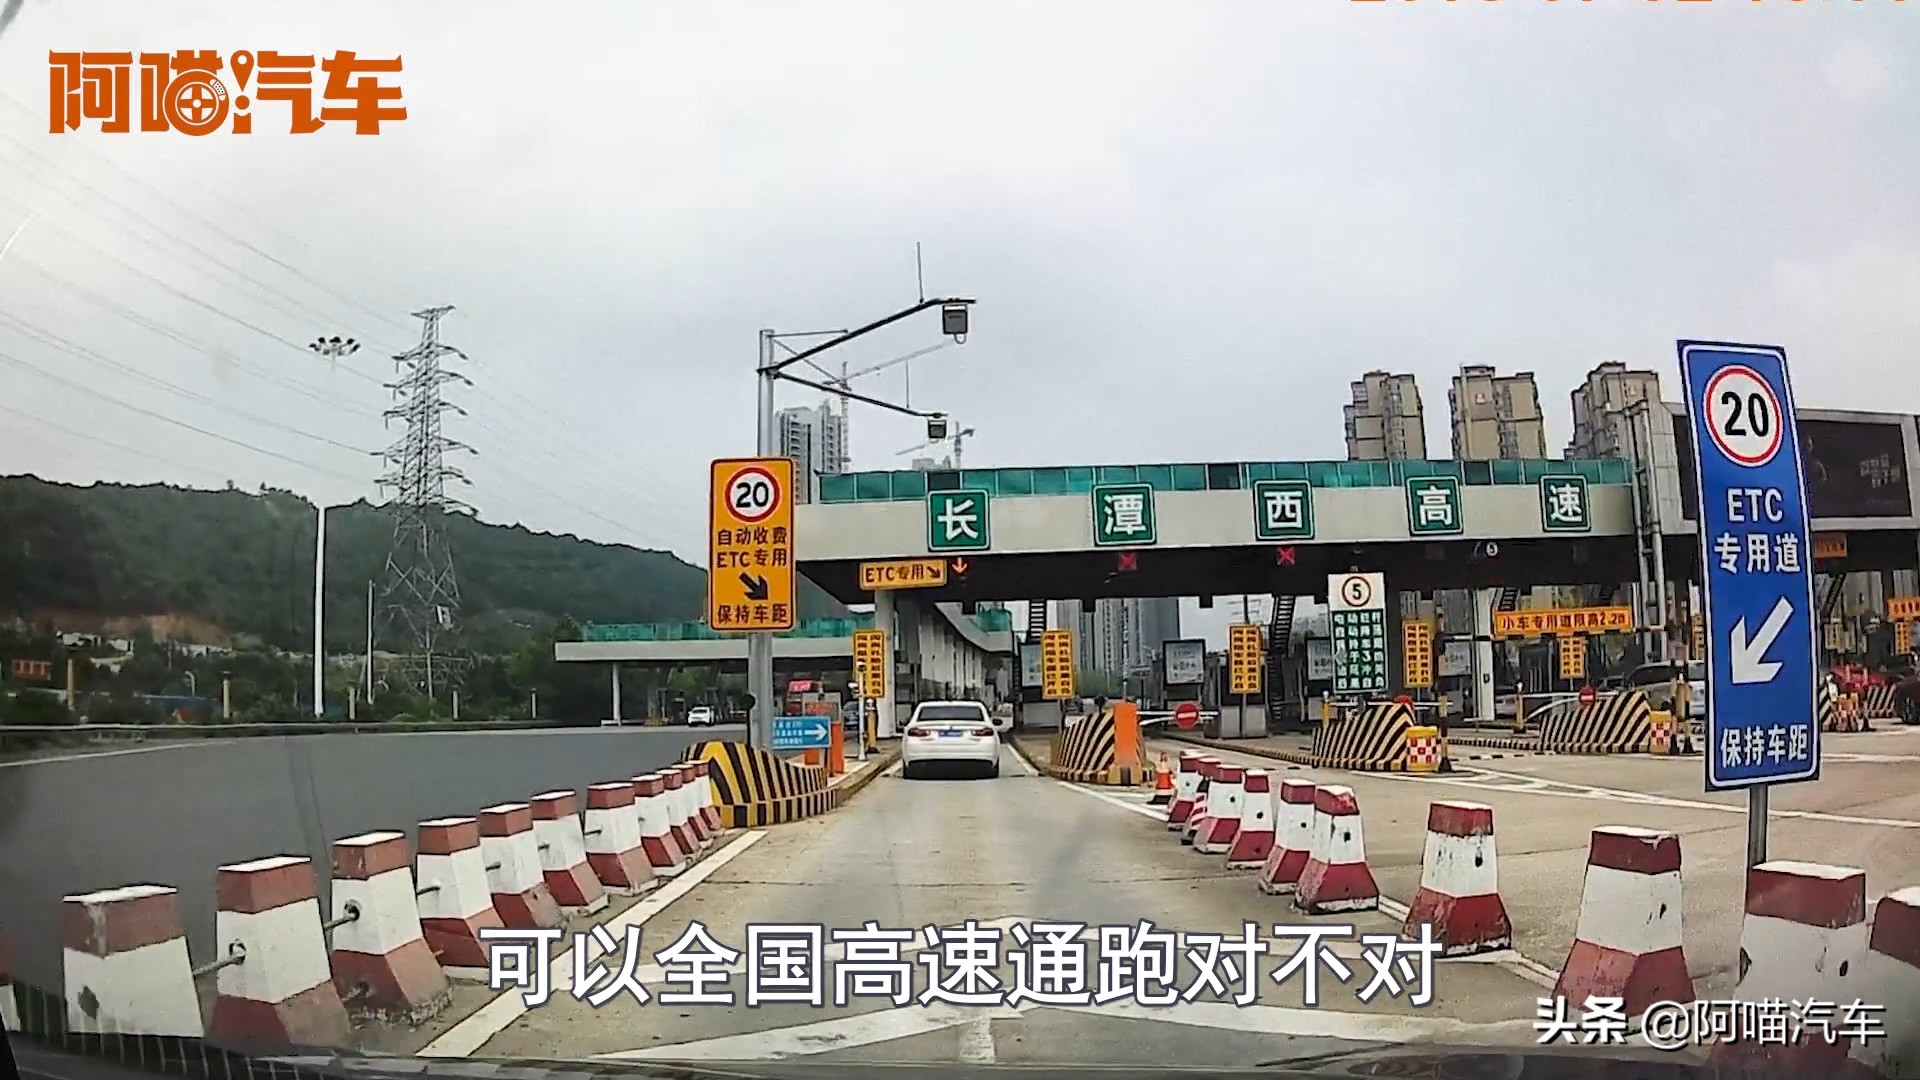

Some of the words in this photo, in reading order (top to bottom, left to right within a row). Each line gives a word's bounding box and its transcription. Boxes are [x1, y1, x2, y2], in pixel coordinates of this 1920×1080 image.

[1721, 391, 1769, 438] 20
[735, 482, 770, 508] 20
[1727, 488, 1783, 523] ETC
[717, 526, 788, 546] 自动收费
[1713, 532, 1801, 574] 专用道
[1352, 583, 1362, 600] 5
[717, 603, 788, 624] 保持车距
[1720, 723, 1808, 769] 保持车距
